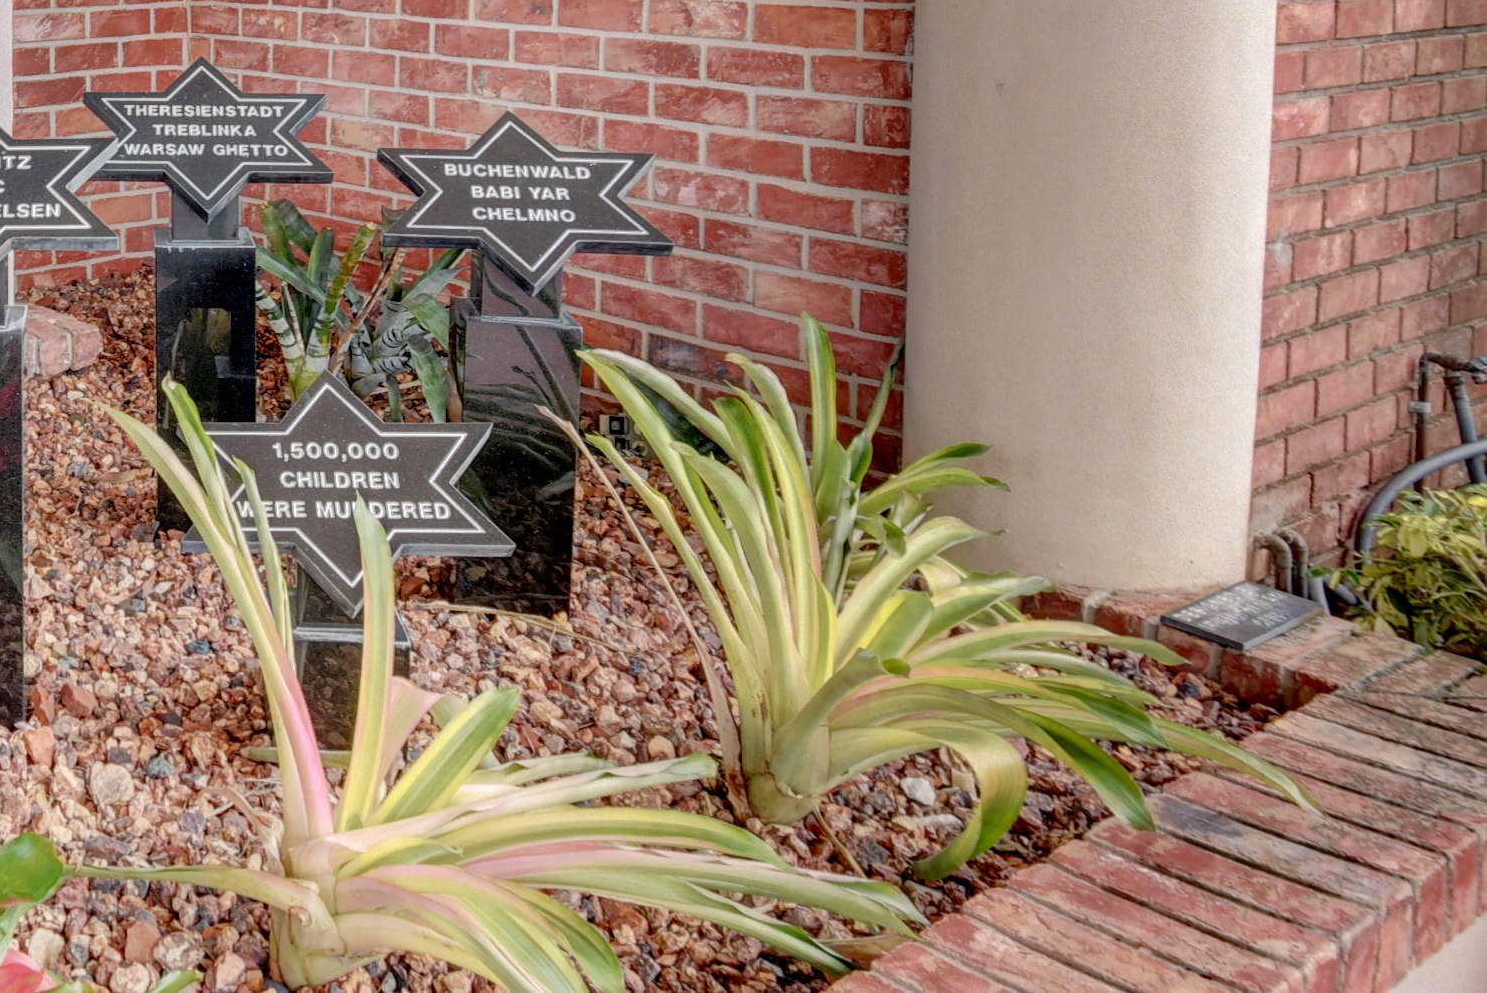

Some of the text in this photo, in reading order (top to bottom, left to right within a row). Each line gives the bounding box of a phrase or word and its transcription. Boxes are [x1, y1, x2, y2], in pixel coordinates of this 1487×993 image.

[124, 104, 284, 118] THERESIENSTADT
[152, 124, 257, 137] TREBLINKA
[124, 143, 288, 157] WARSAW GHETTO
[444, 163, 591, 180] BUCHENWALD
[470, 185, 571, 201] BABI YAR
[471, 207, 576, 223] CHELMNO
[272, 442, 400, 462] 1,500,000
[279, 471, 401, 489] CHILDREN
[236, 500, 452, 520] WERE MUDERED
